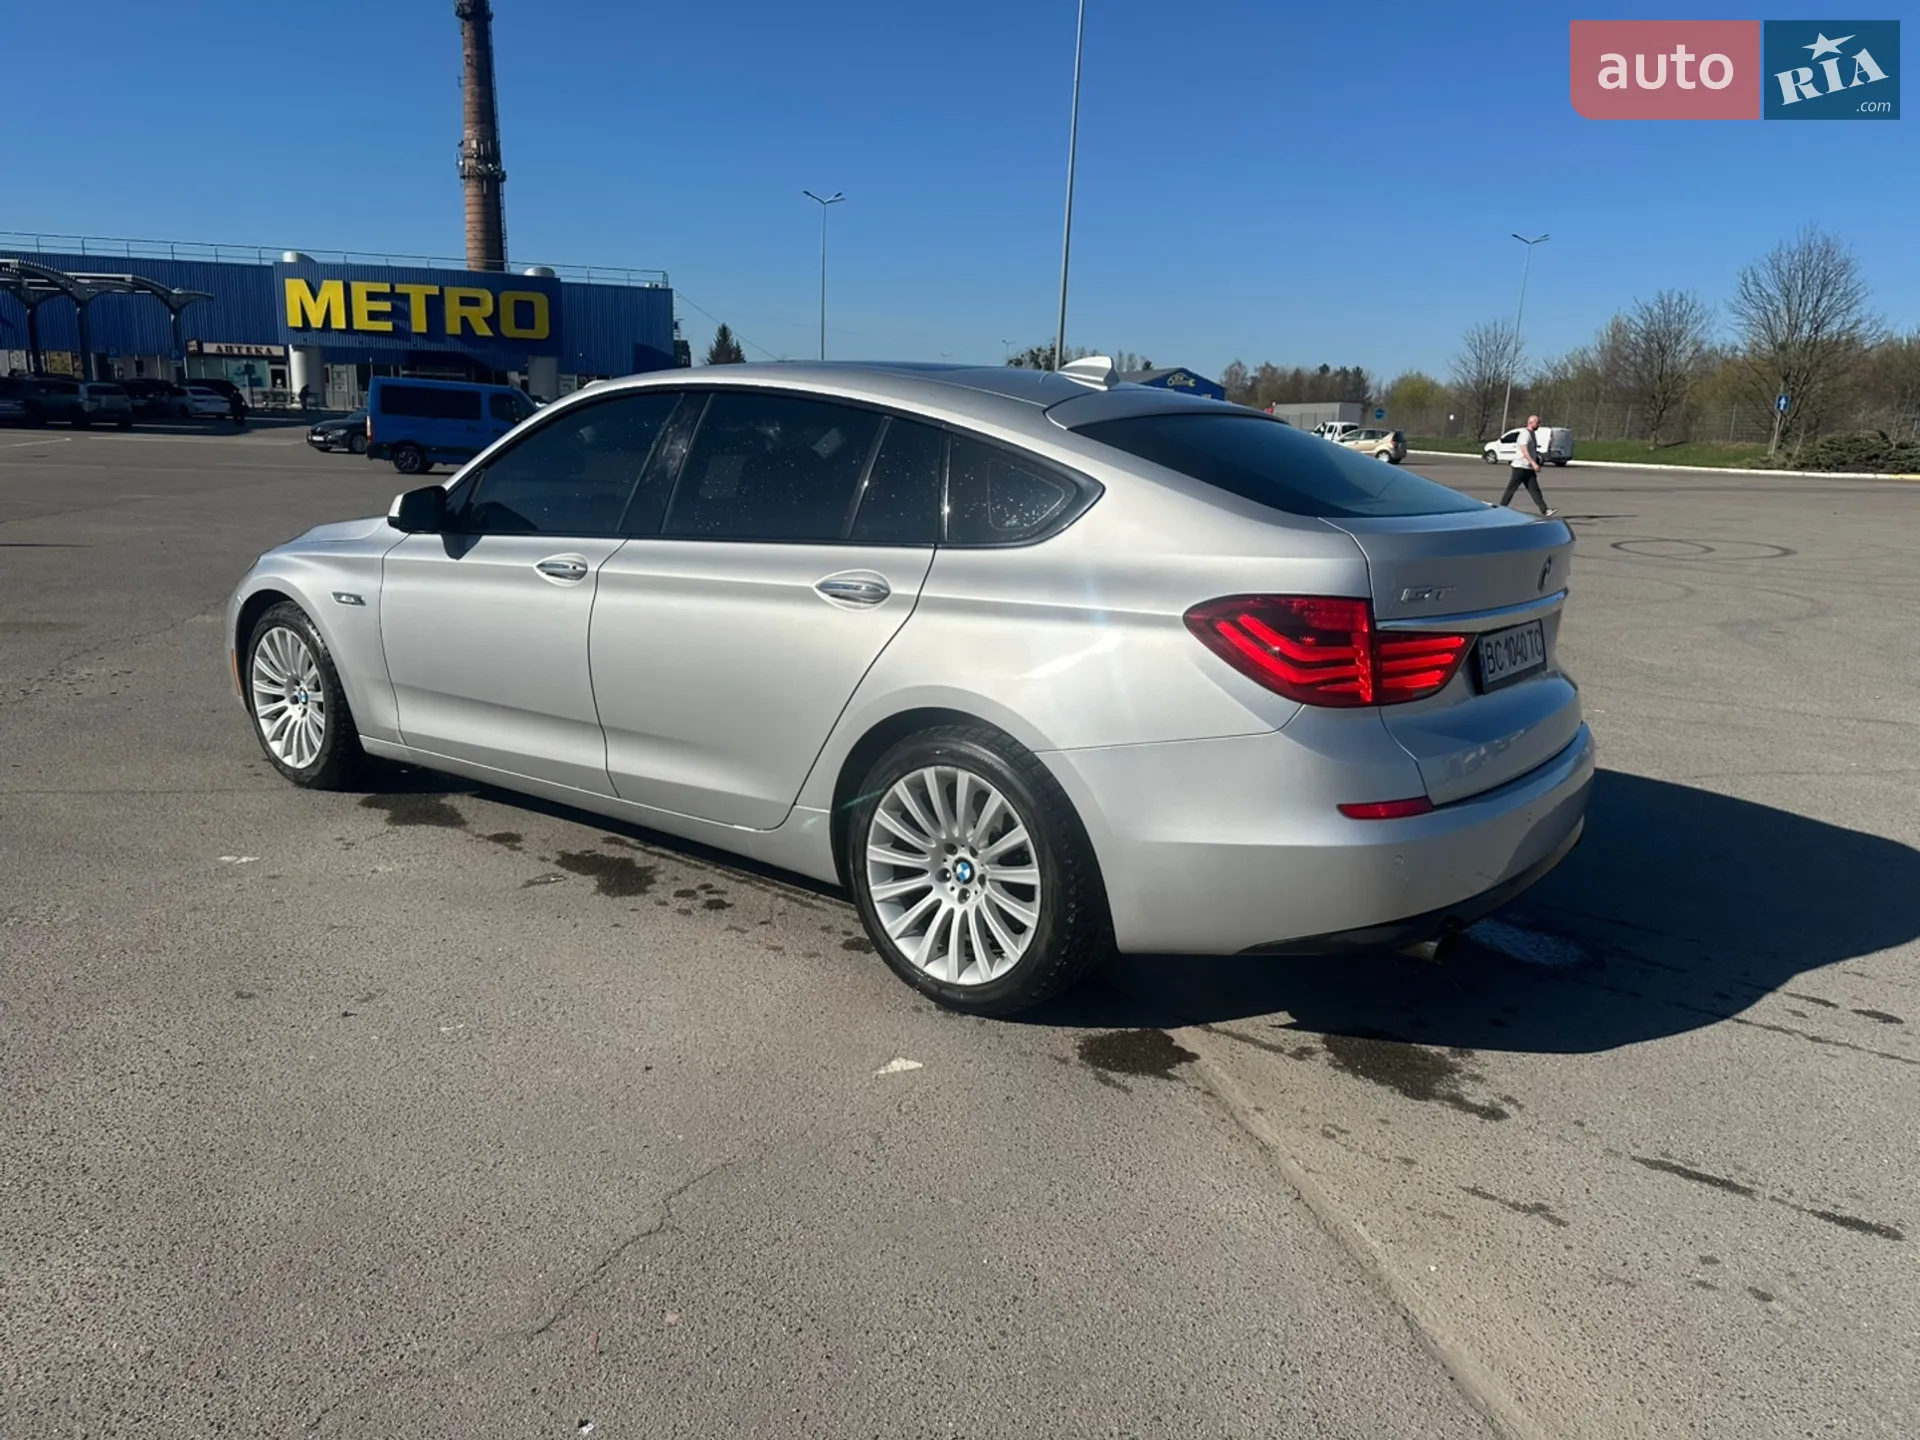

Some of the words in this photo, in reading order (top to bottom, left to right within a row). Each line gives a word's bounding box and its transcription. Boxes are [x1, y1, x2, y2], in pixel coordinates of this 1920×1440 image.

[284, 278, 550, 340] METRO
[214, 344, 274, 355] АПТЕКА
[1485, 640, 1504, 675] BC
[1526, 628, 1543, 659] TC
